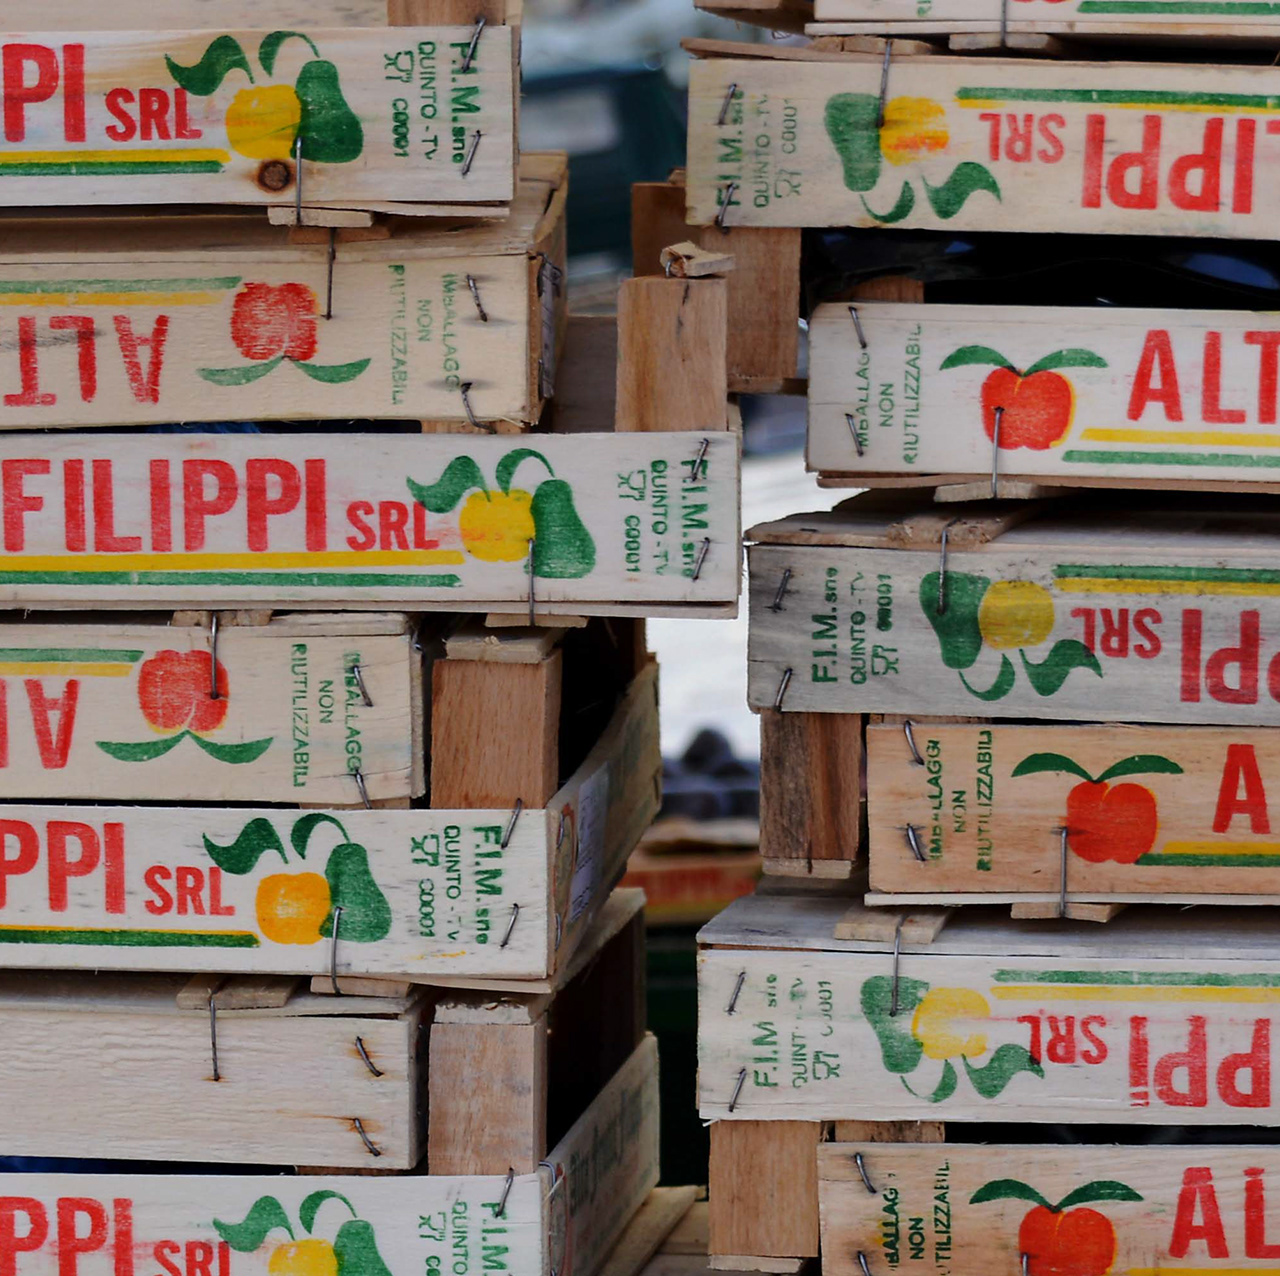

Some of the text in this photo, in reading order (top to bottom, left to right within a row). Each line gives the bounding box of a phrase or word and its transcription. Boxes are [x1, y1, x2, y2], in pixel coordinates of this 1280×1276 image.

[419, 41, 437, 120] QUINTO
[105, 87, 202, 142] SRL
[979, 112, 1066, 163] SRL
[878, 383, 894, 428] NON
[1, 458, 328, 552] FILIPPI
[346, 500, 440, 551] SRL
[651, 459, 668, 535] QUINTO
[850, 611, 867, 685] QUINTO
[1072, 608, 1162, 659] SRL
[319, 679, 335, 725] NON
[951, 790, 967, 834] NON
[443, 825, 461, 900] QUINTO
[144, 865, 235, 916] SRL
[1017, 1014, 1109, 1064] SRL
